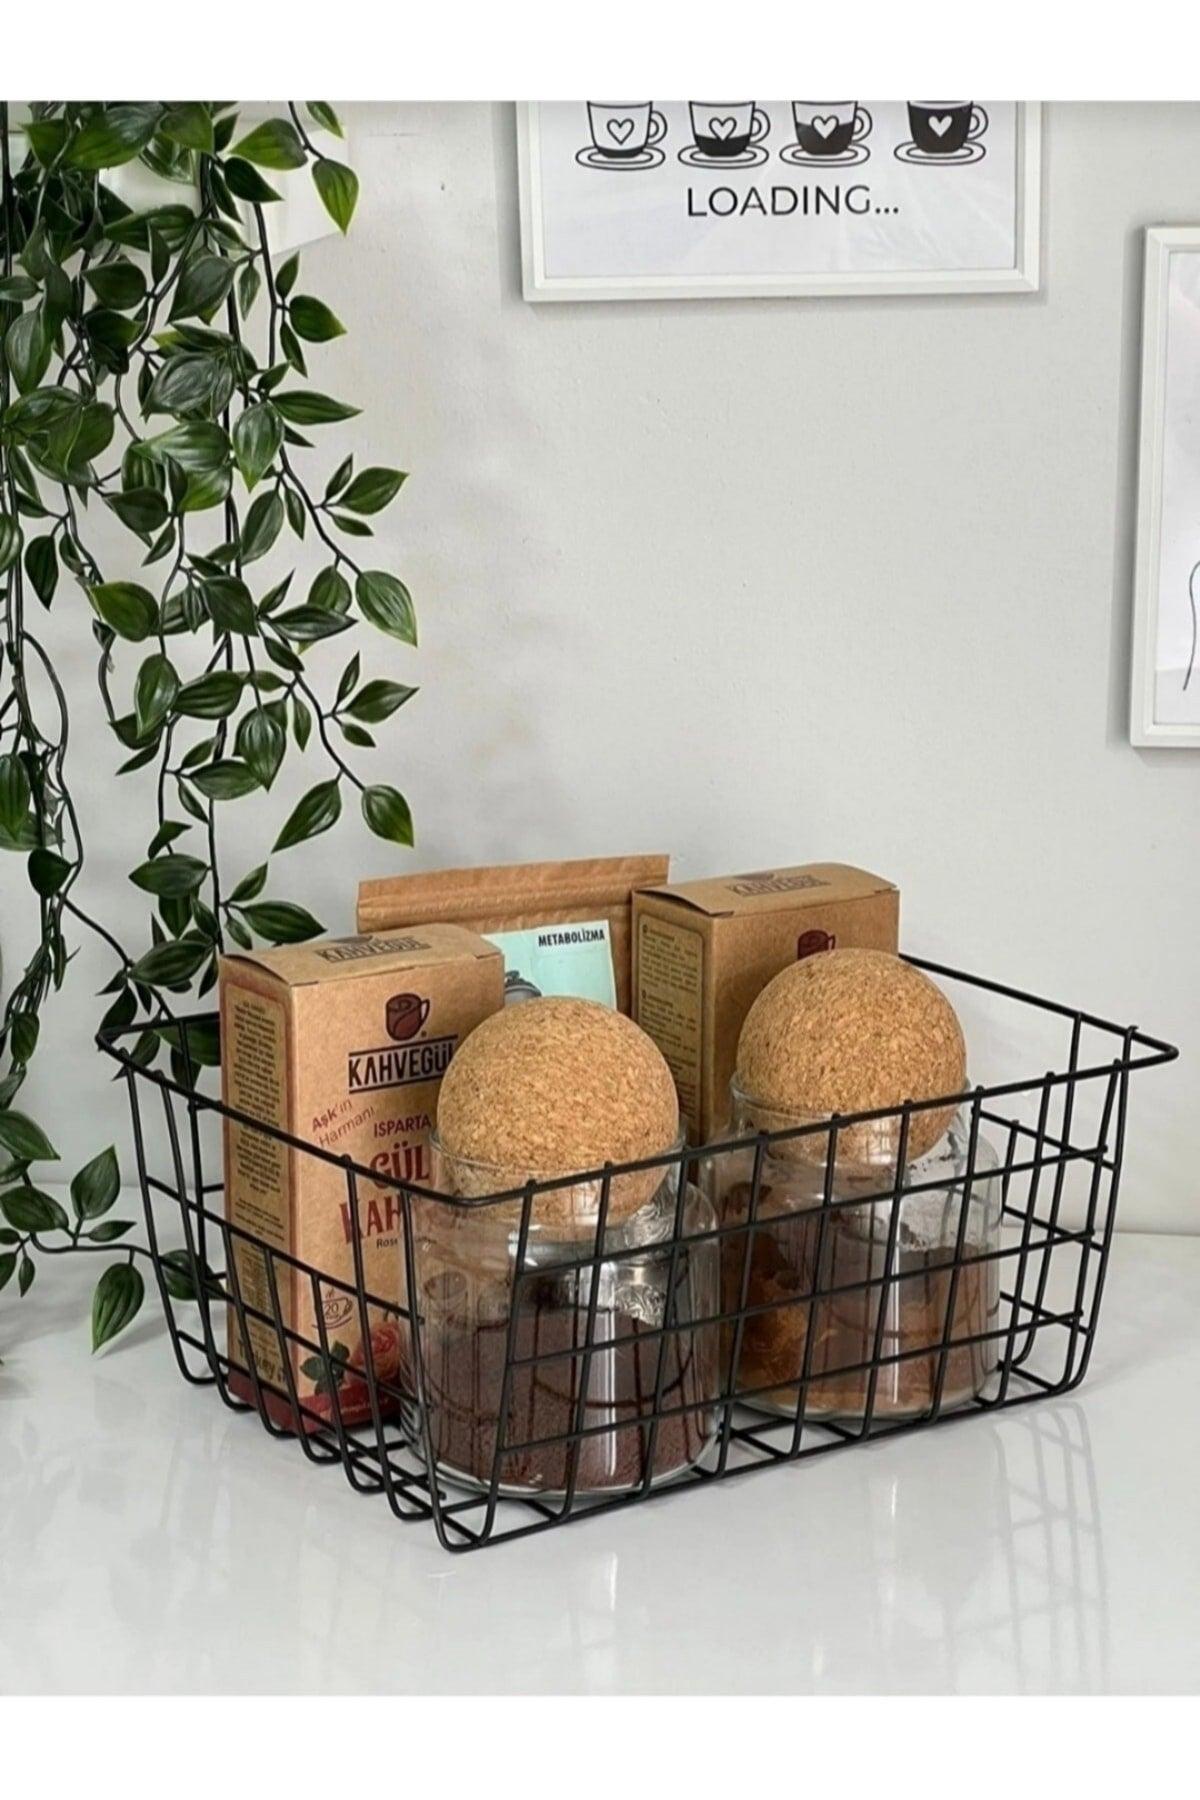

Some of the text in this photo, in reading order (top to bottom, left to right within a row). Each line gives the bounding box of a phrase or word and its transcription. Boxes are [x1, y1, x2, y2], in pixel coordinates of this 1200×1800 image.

[687, 184, 899, 217] LOADING...
[538, 928, 605, 947] METABOLİZMA
[318, 1106, 376, 1147] Harmanı
[374, 1114, 432, 1138] ISPARTA
[369, 1141, 430, 1190] GÜL
